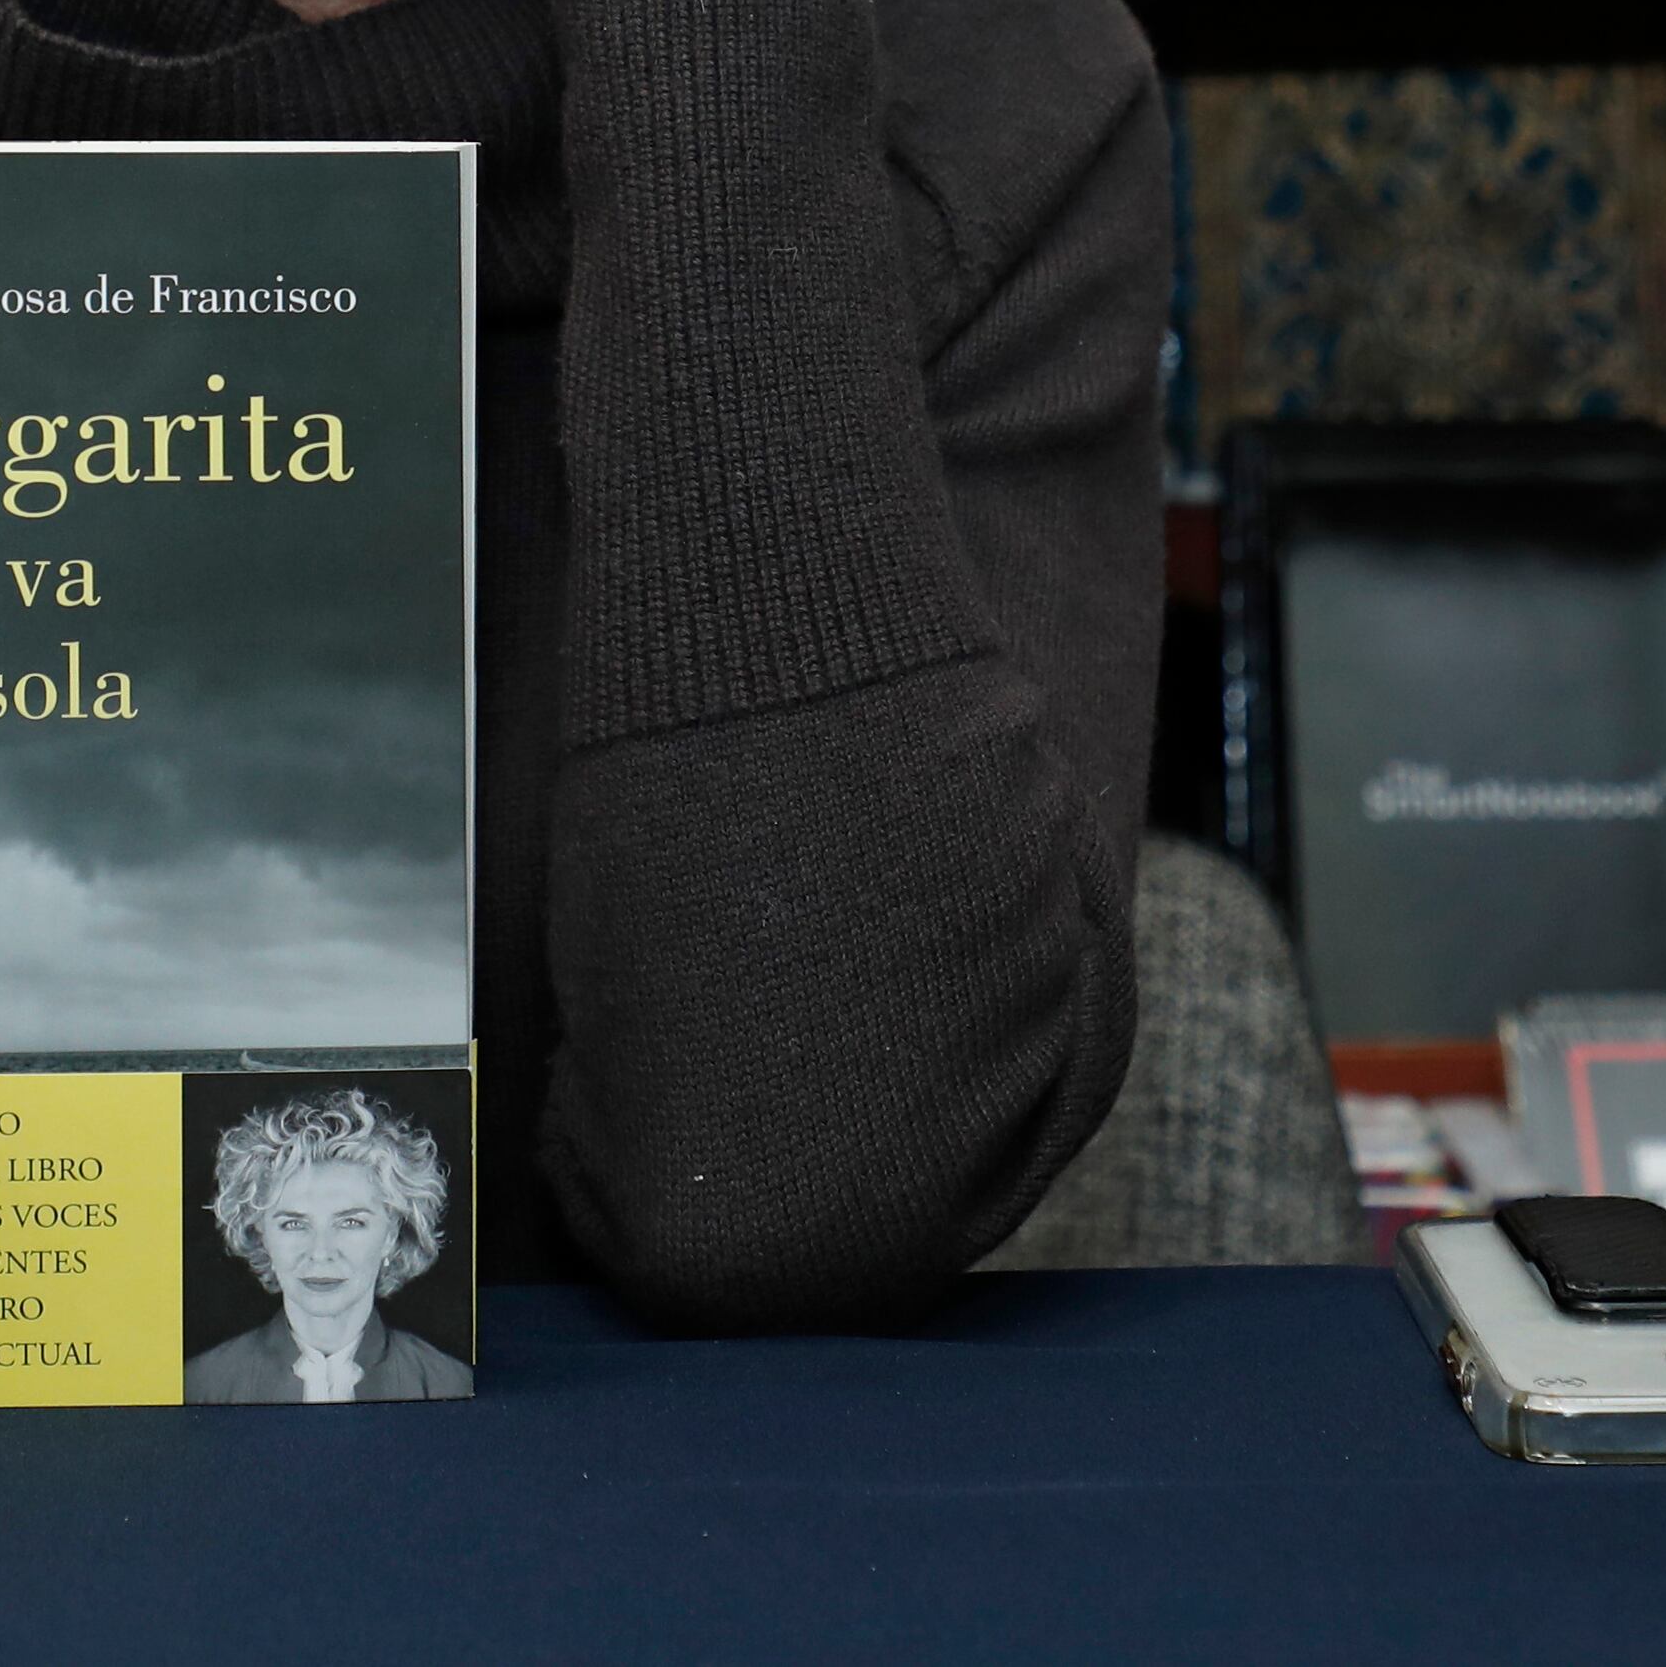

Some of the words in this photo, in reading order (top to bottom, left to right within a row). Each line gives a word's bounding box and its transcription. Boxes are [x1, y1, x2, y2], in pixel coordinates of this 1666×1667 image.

[84, 272, 134, 315] de
[149, 273, 357, 315] Francisco
[5, 558, 102, 608] va
[9, 1156, 103, 1183] LIBRO
[12, 1202, 118, 1230] VOCES
